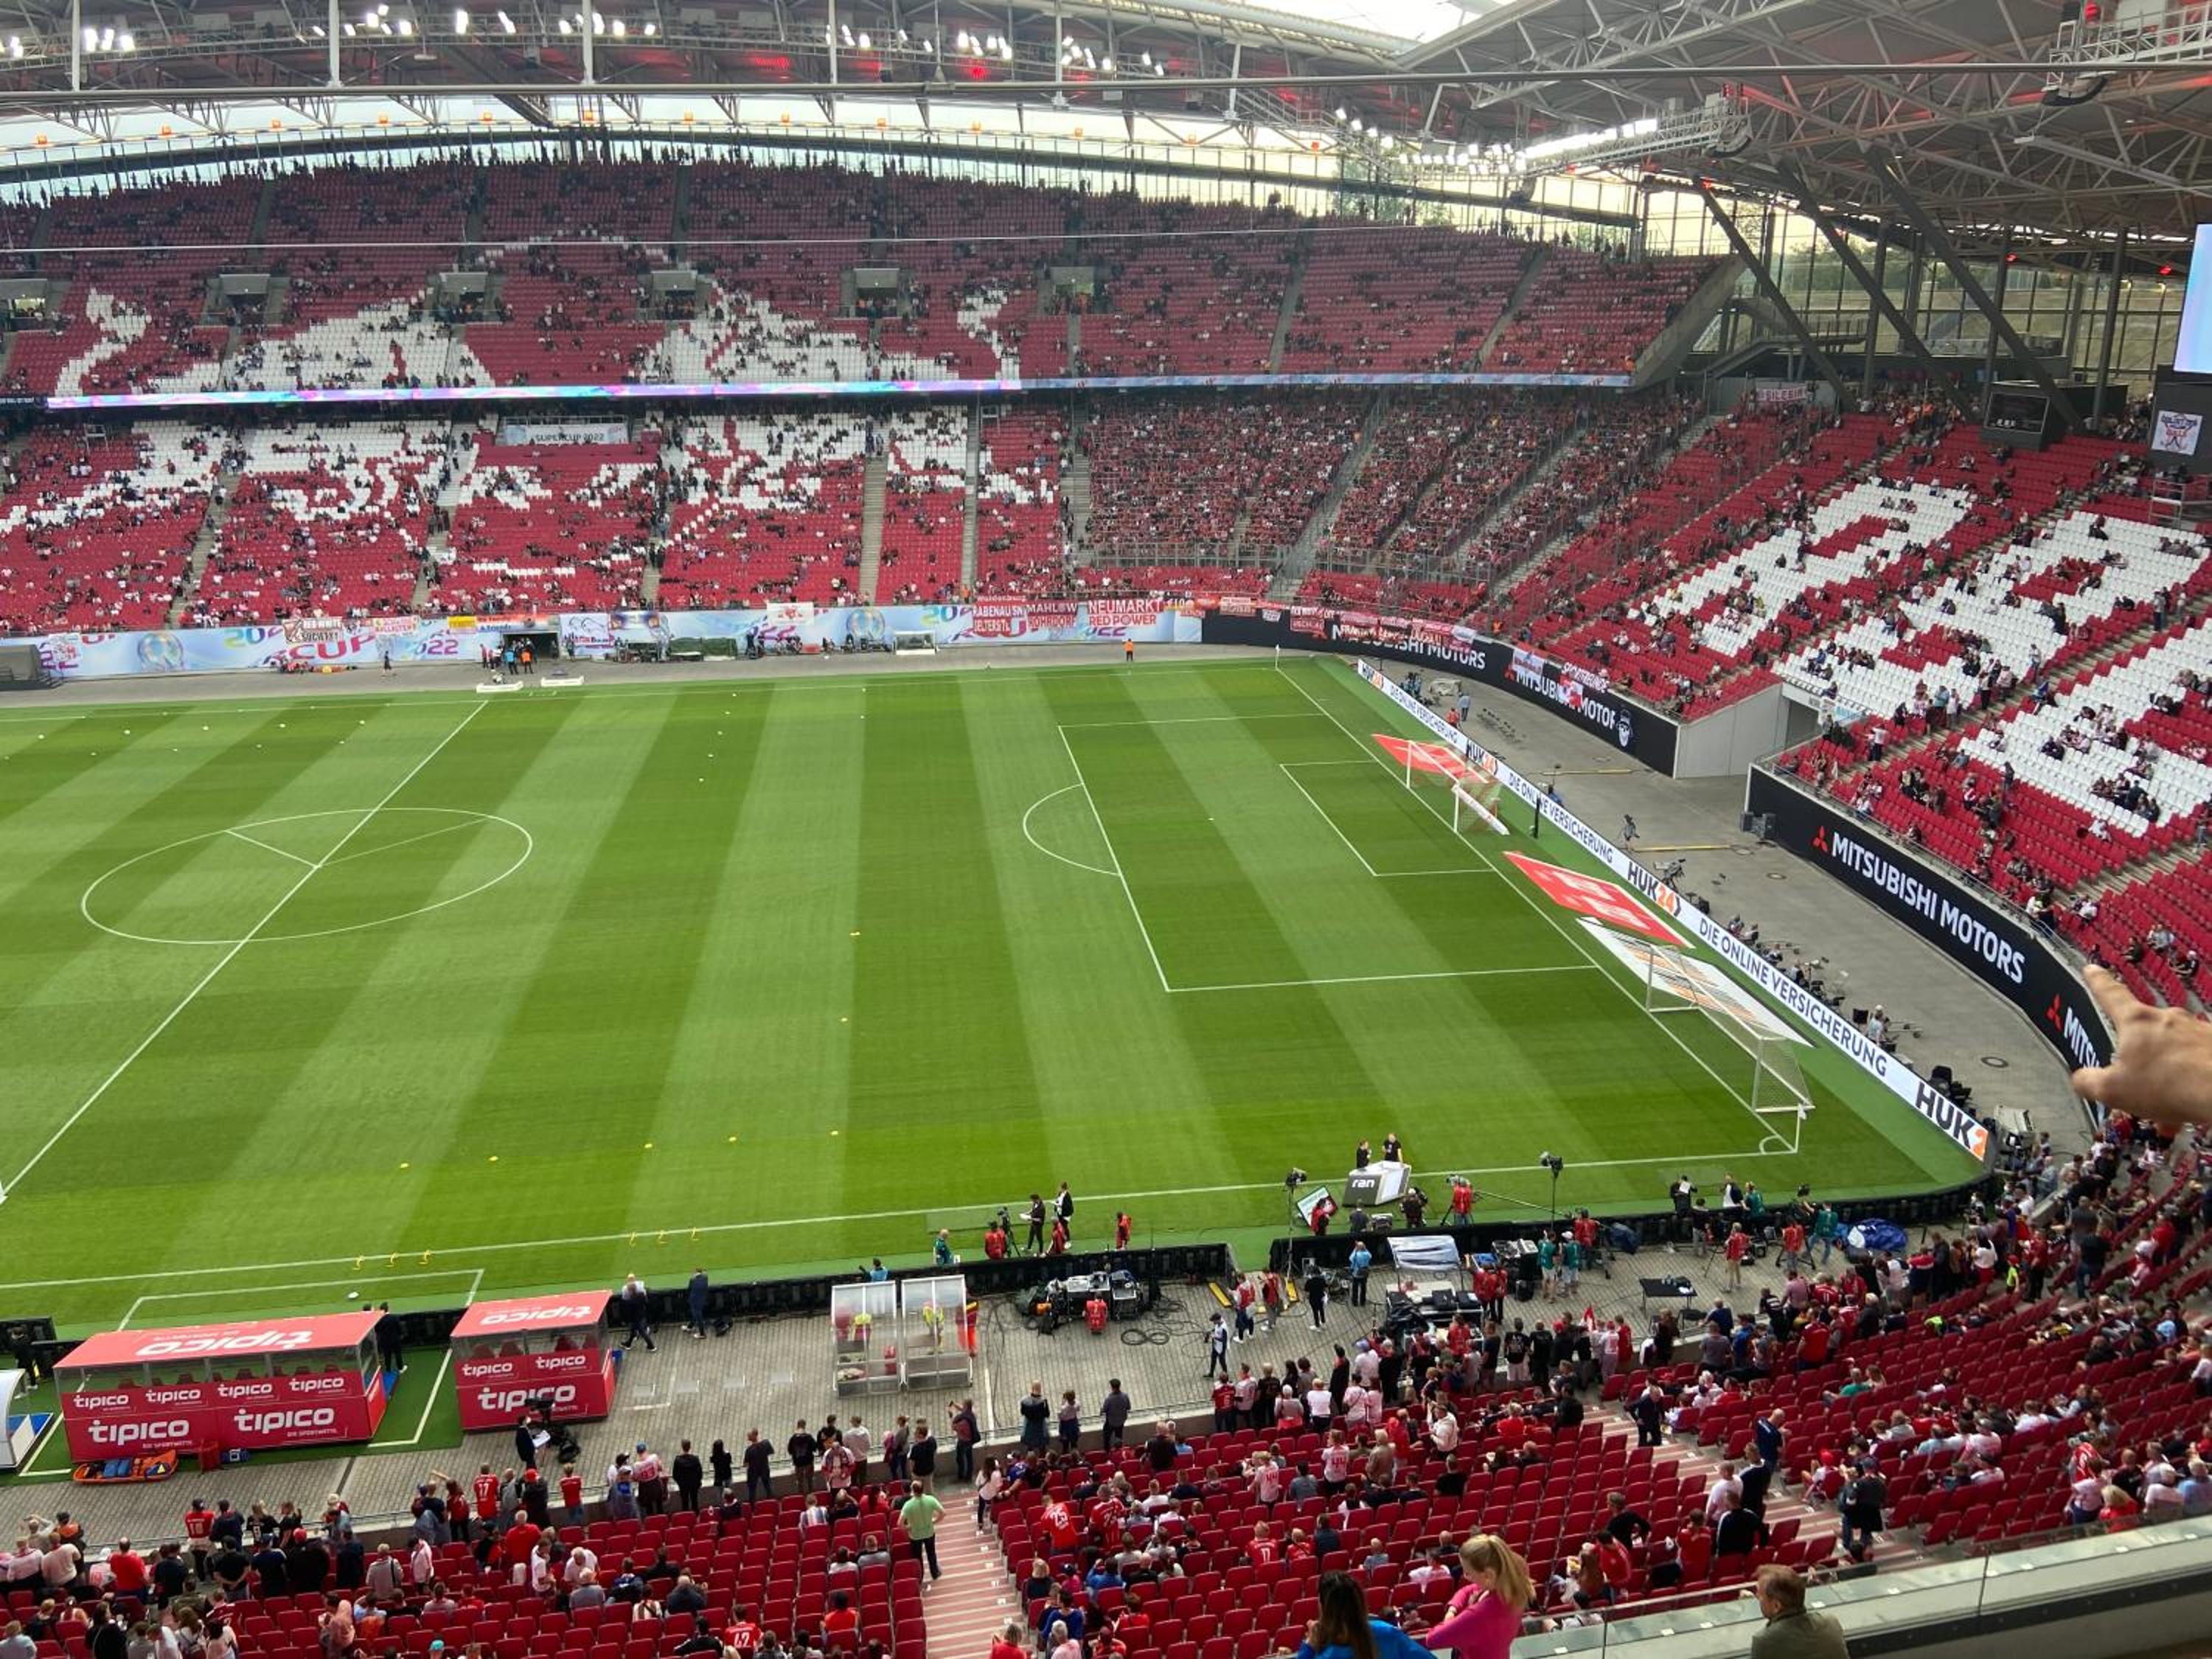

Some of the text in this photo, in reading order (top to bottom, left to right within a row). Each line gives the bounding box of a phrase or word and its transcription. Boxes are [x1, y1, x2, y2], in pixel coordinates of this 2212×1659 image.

[1088, 599, 1163, 614] NEUMARKT
[1089, 613, 1157, 626] RED POWER
[1509, 772, 1520, 793] DIE
[1549, 804, 1613, 863] VERSICHERUNG
[1831, 831, 2025, 985] MITSUBISHI MOTORS
[1699, 917, 1888, 1078] DIE ONLINE VERSICHERUNG
[1352, 1179, 1375, 1188] ran
[462, 1363, 513, 1377] tipico
[535, 1354, 586, 1370] tipico
[218, 1384, 273, 1399] tipico
[289, 1377, 345, 1394] tipico
[74, 1394, 129, 1410] tipico
[146, 1389, 201, 1405] tipico
[234, 1408, 335, 1434] tipico
[88, 1419, 189, 1446] tipico
[478, 1482, 489, 1498] 17
